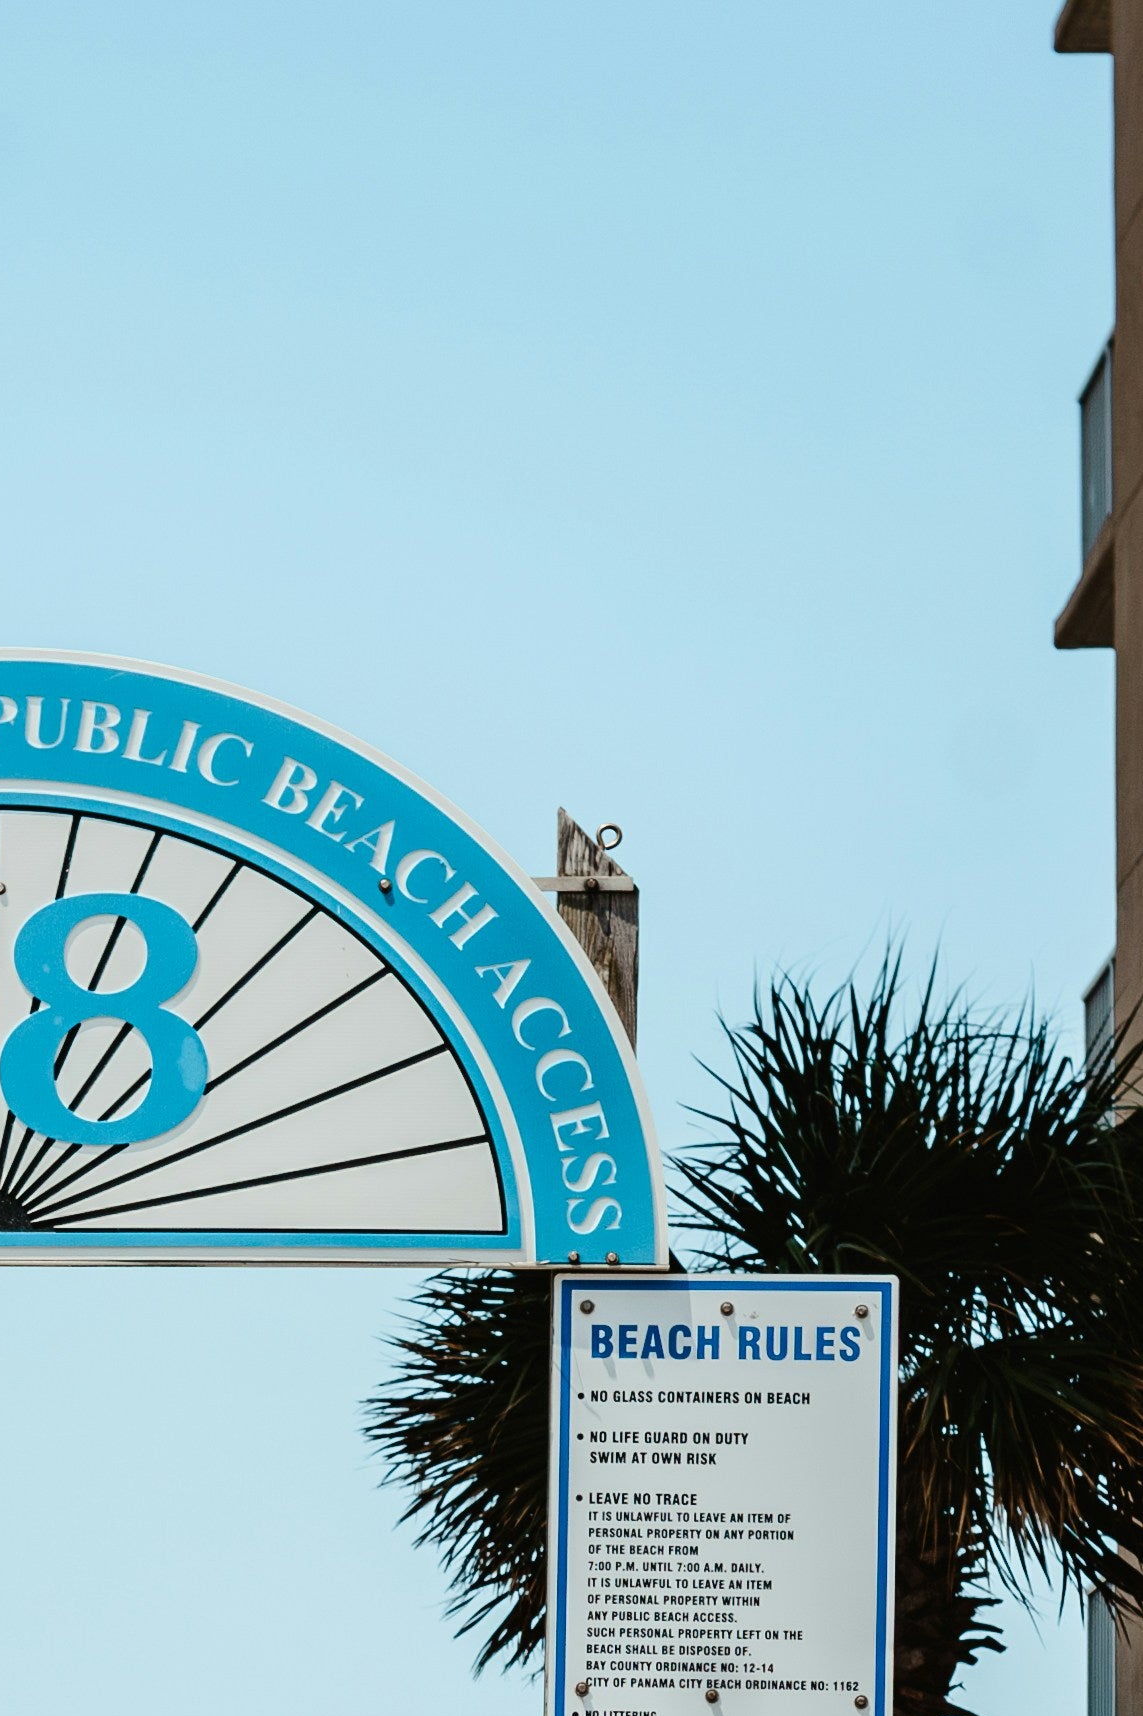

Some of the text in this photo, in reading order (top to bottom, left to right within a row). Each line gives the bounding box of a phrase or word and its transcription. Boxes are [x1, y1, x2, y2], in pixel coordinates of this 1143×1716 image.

[260, 755, 500, 952] BEACH
[475, 957, 623, 1236] ACCESS
[591, 1324, 860, 1361] BEACH RULES
[590, 1390, 810, 1404] NO GLASS CONTAINERS ON BEACH
[589, 1430, 748, 1445] NO LIFE GUARD ON DUTY
[589, 1451, 716, 1465] SWIM AT OWN RISK
[589, 1492, 697, 1505] LEAVE NO TRACE
[588, 1561, 764, 1573] 7:00 P.M. UNTIL 7:00 A.M. DAILY.
